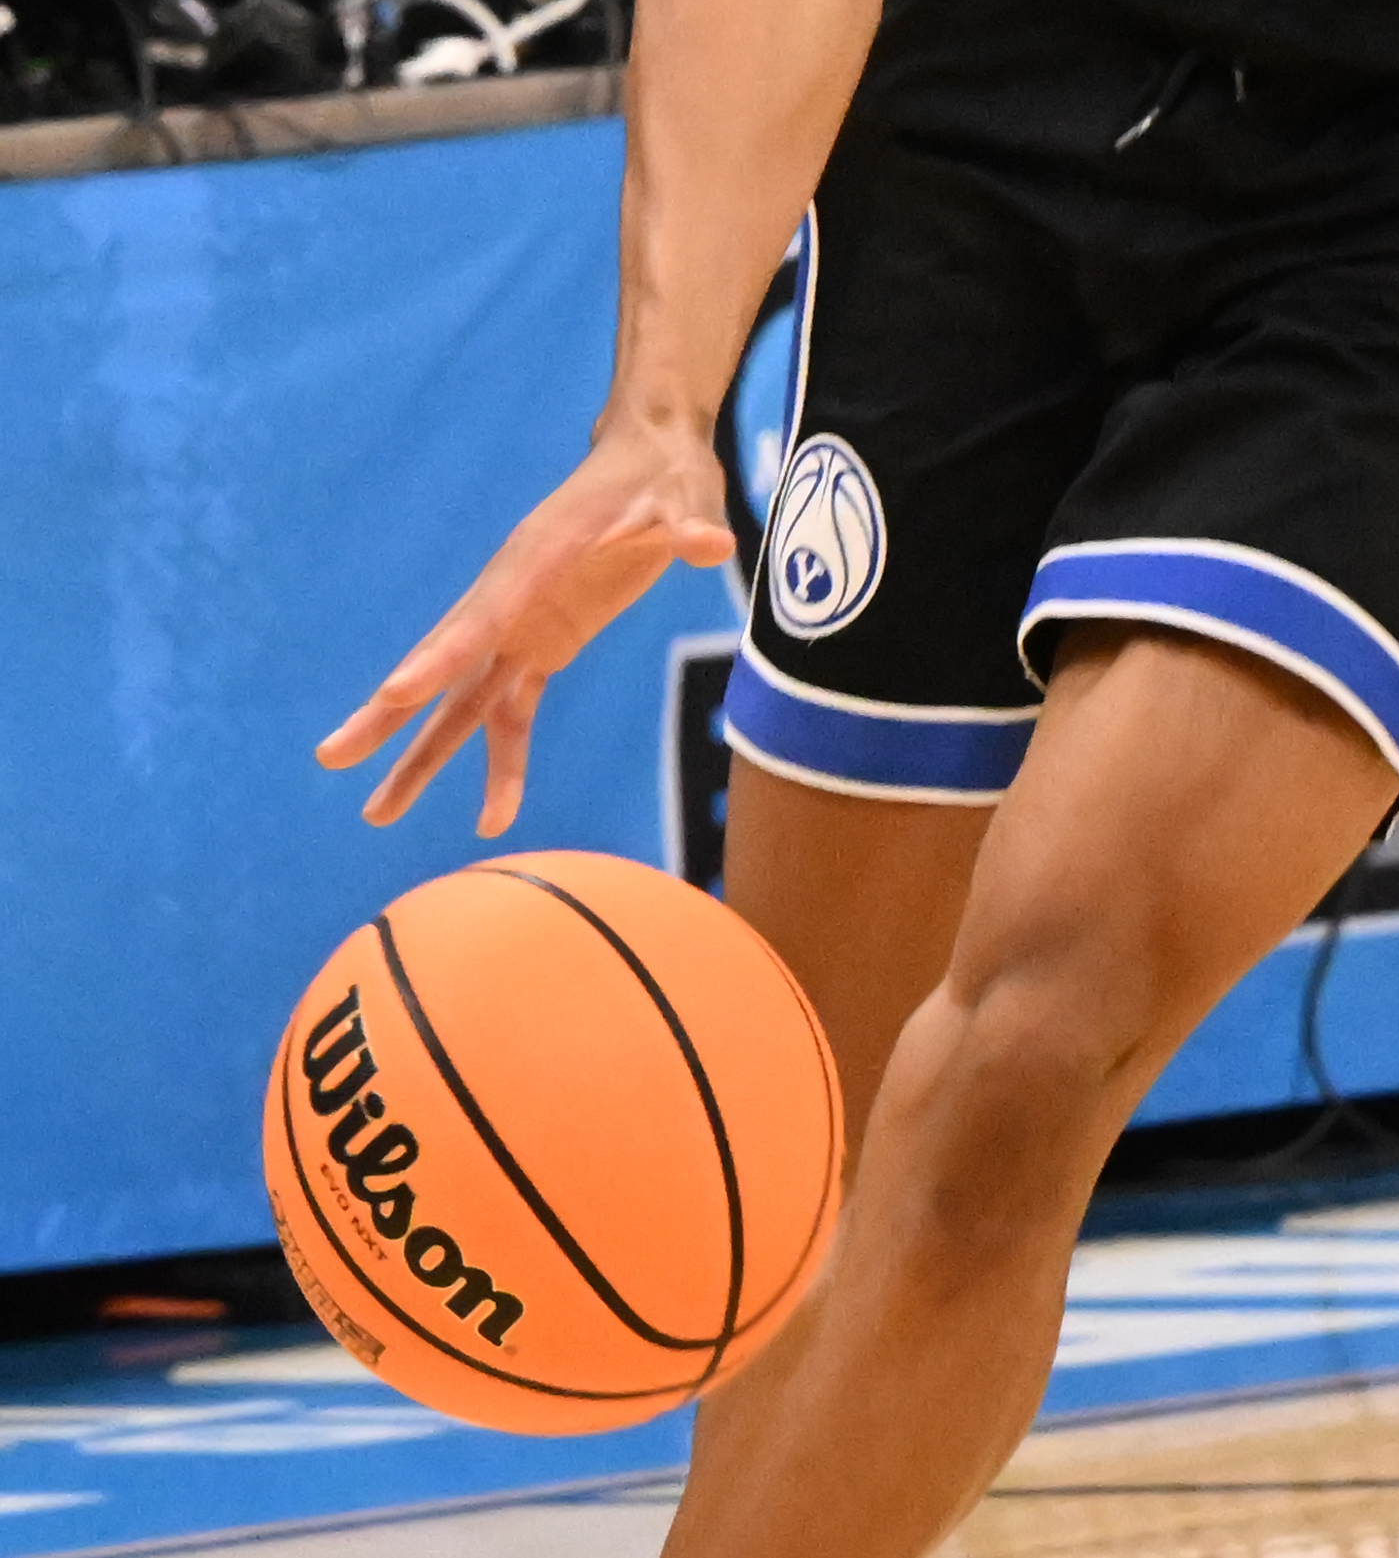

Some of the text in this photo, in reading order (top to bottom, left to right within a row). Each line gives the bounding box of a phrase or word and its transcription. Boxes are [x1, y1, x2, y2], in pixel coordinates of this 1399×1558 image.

[794, 549, 826, 602] Y
[302, 984, 525, 1347] Wilson
[351, 1214, 388, 1261] NXT
